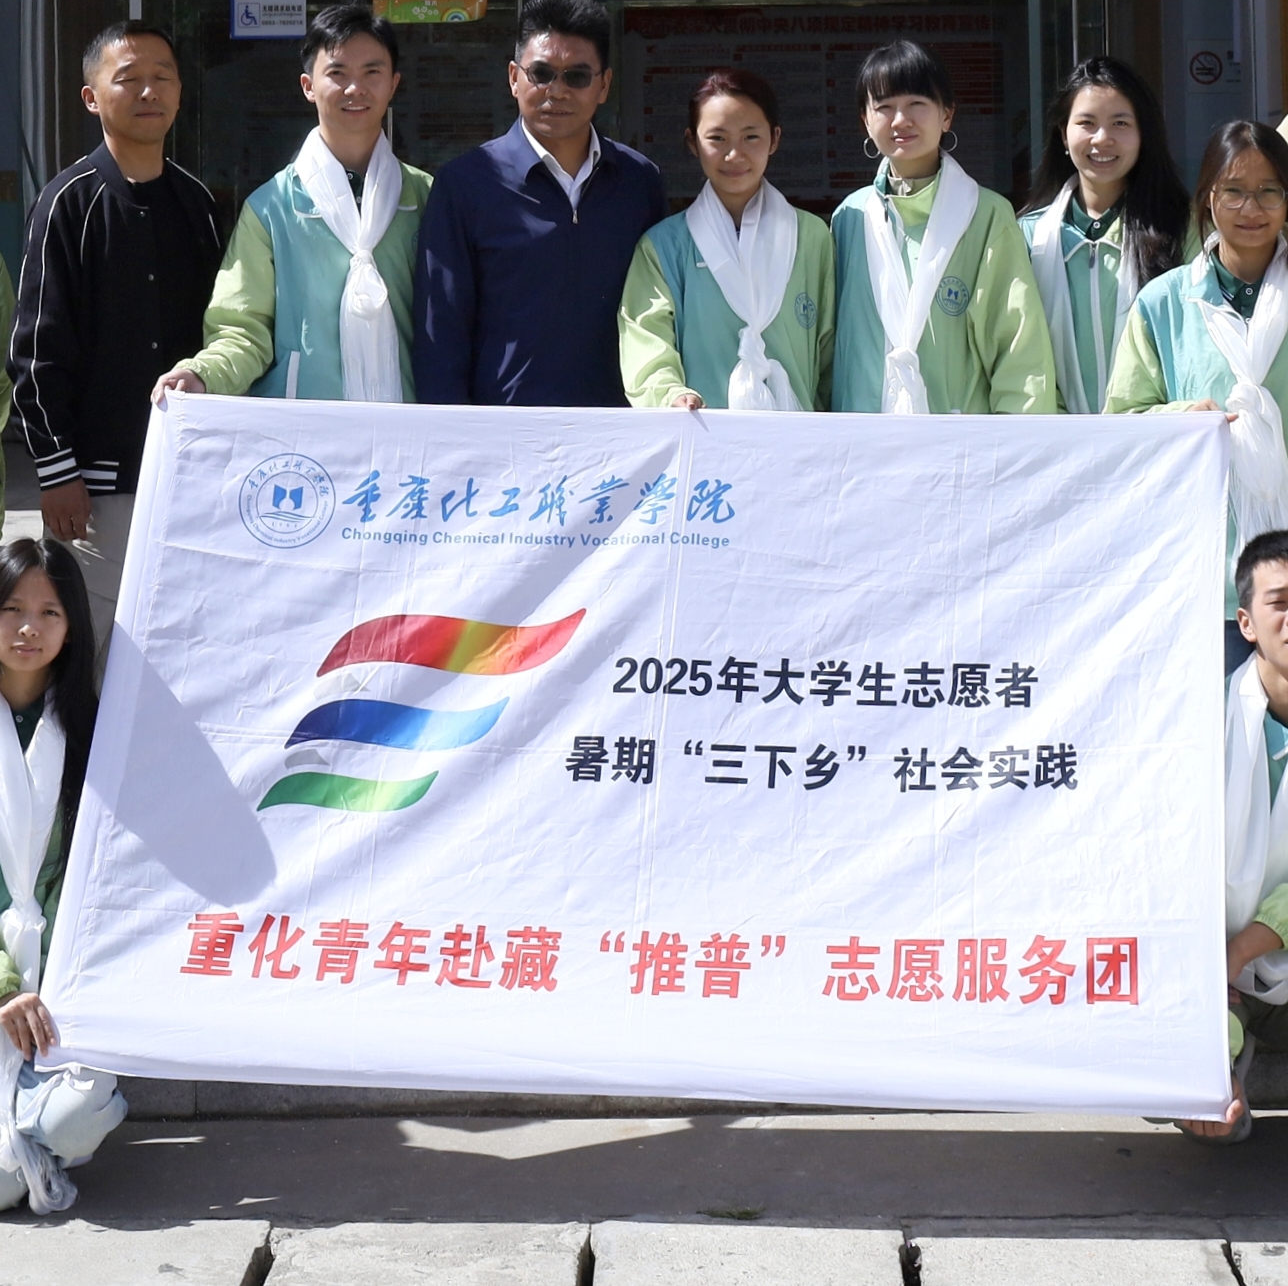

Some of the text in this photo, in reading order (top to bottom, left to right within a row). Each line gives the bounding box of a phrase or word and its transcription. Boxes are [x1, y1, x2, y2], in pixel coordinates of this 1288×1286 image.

[341, 526, 731, 550] Chongqing Chemical Industry Vocational College
[612, 655, 1040, 709] 2025年大学生志愿者
